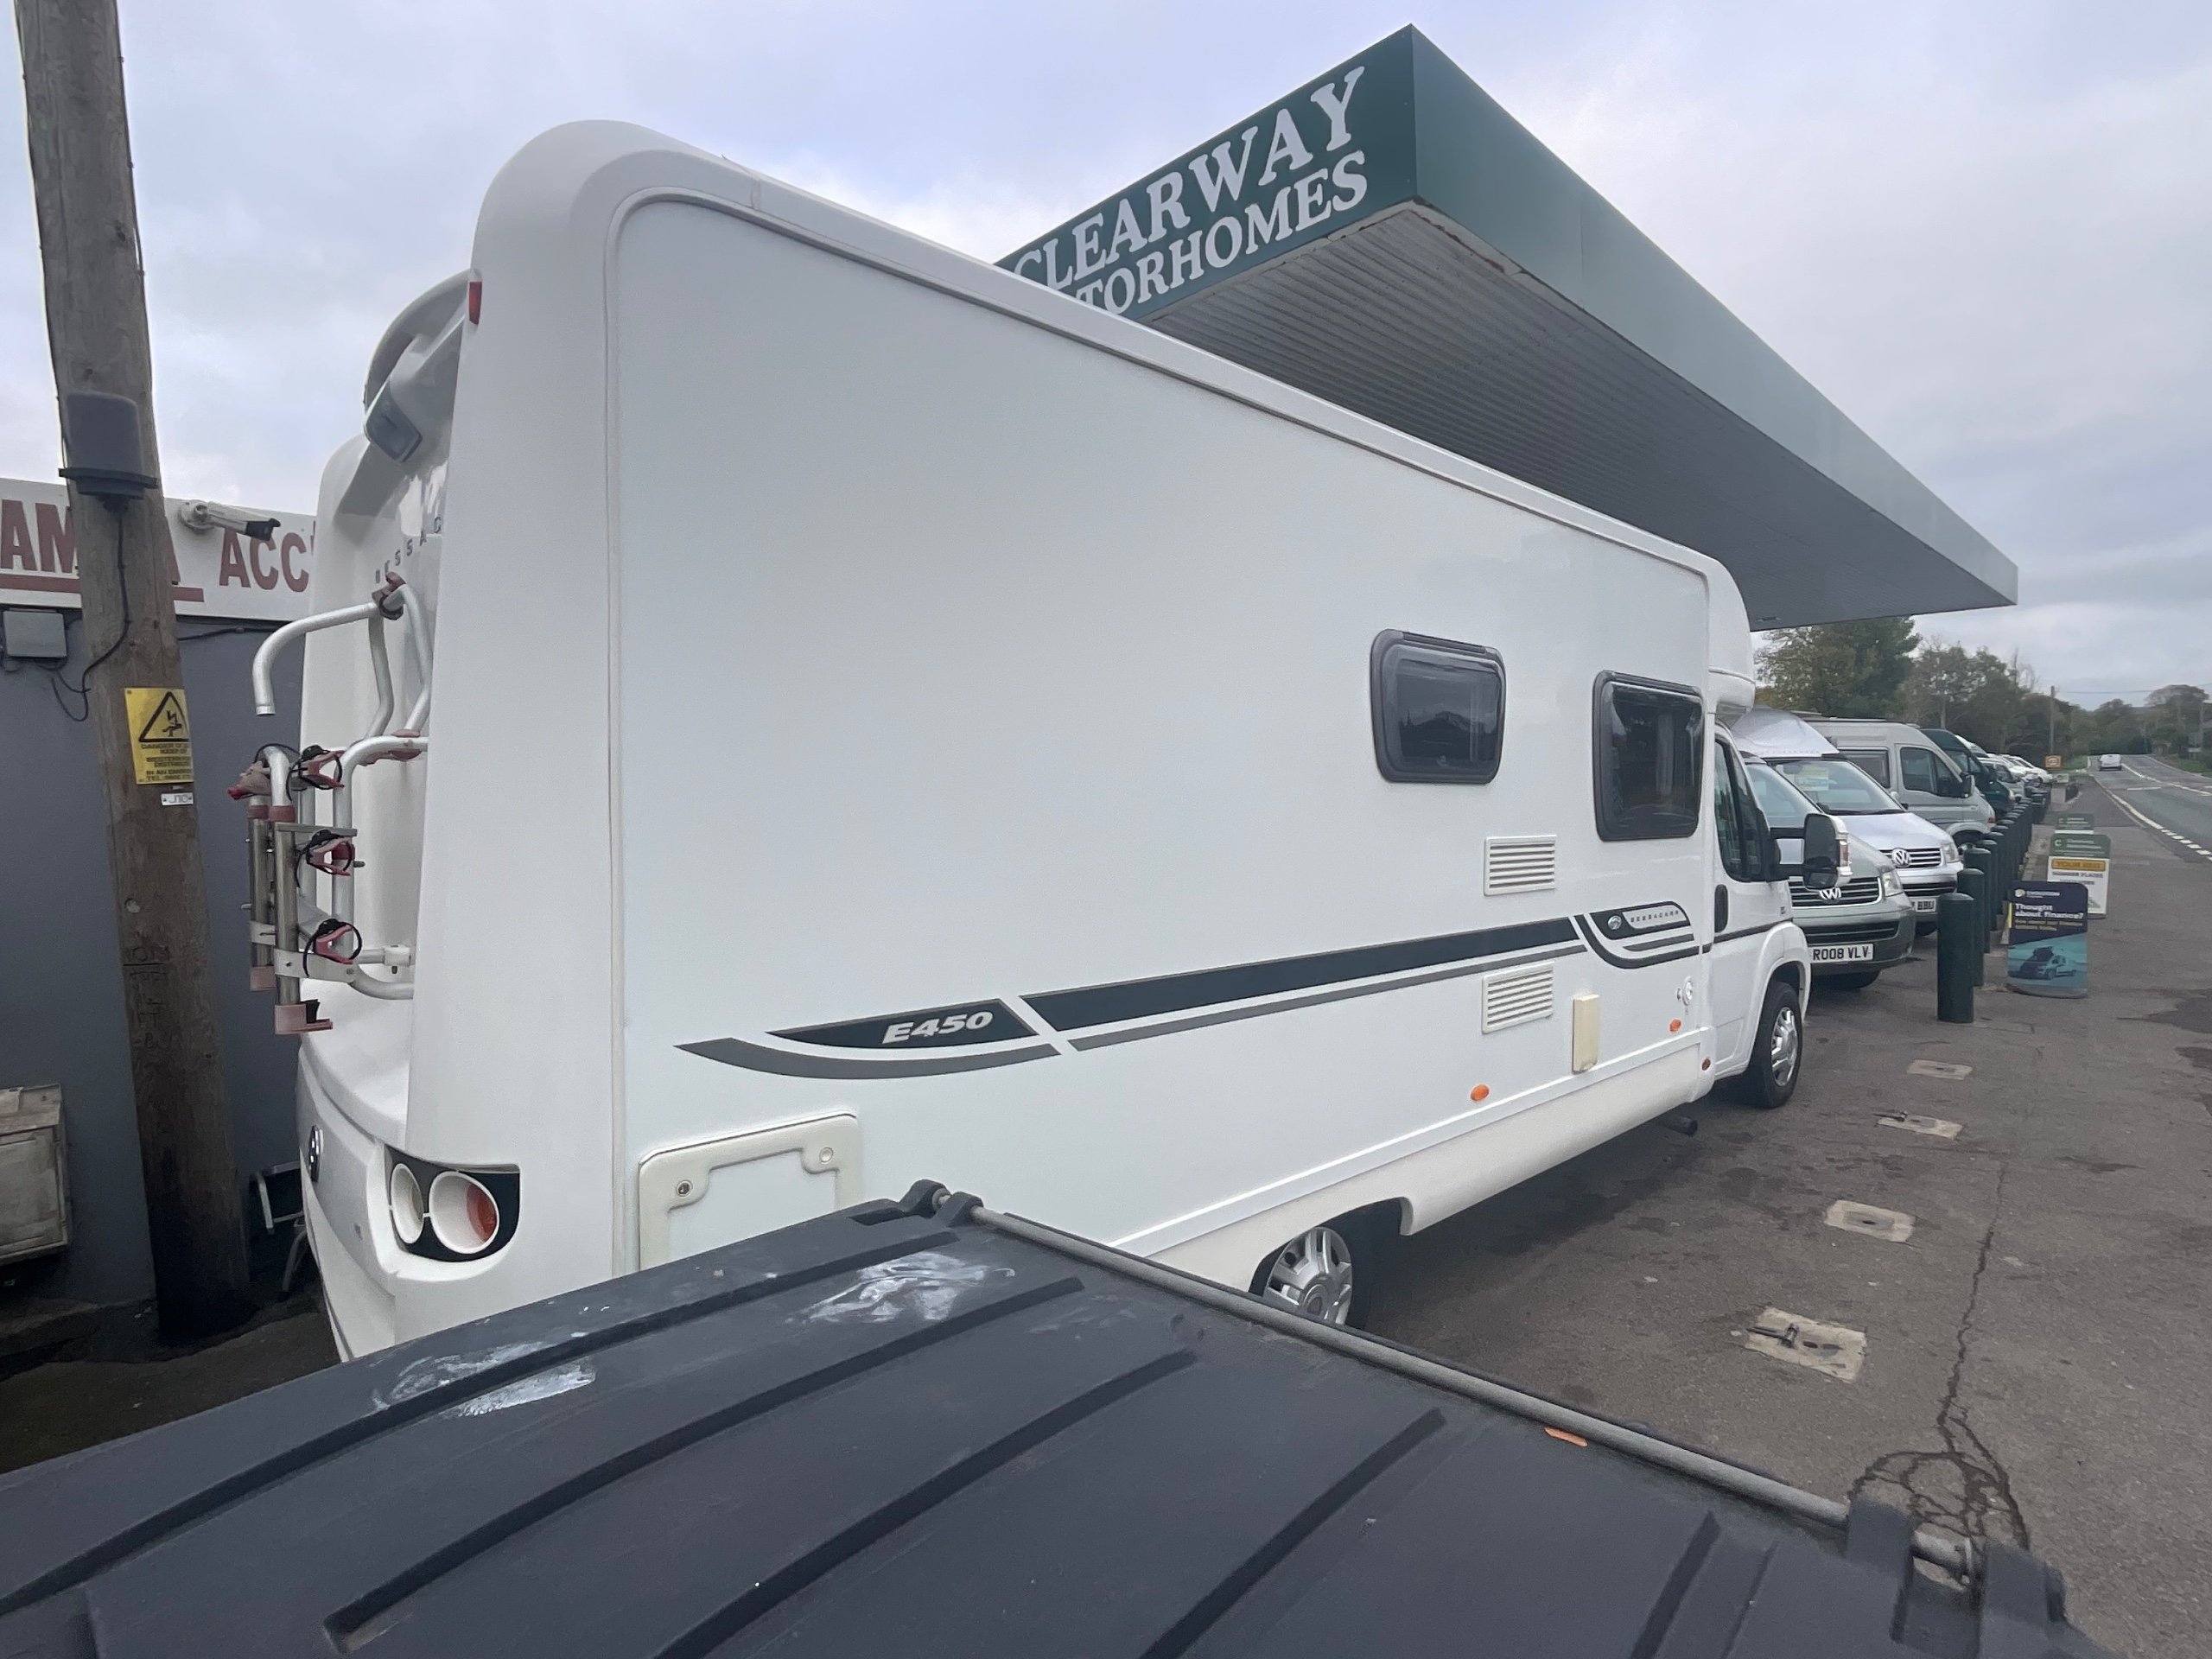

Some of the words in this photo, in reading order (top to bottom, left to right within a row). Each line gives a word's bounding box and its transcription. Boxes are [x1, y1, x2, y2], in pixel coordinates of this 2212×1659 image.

[1014, 66, 1364, 290] CLEARWAY
[2015, 903, 2053, 912] Thought
[1847, 945, 1868, 958] VLV
[881, 1011, 994, 1045] E450
